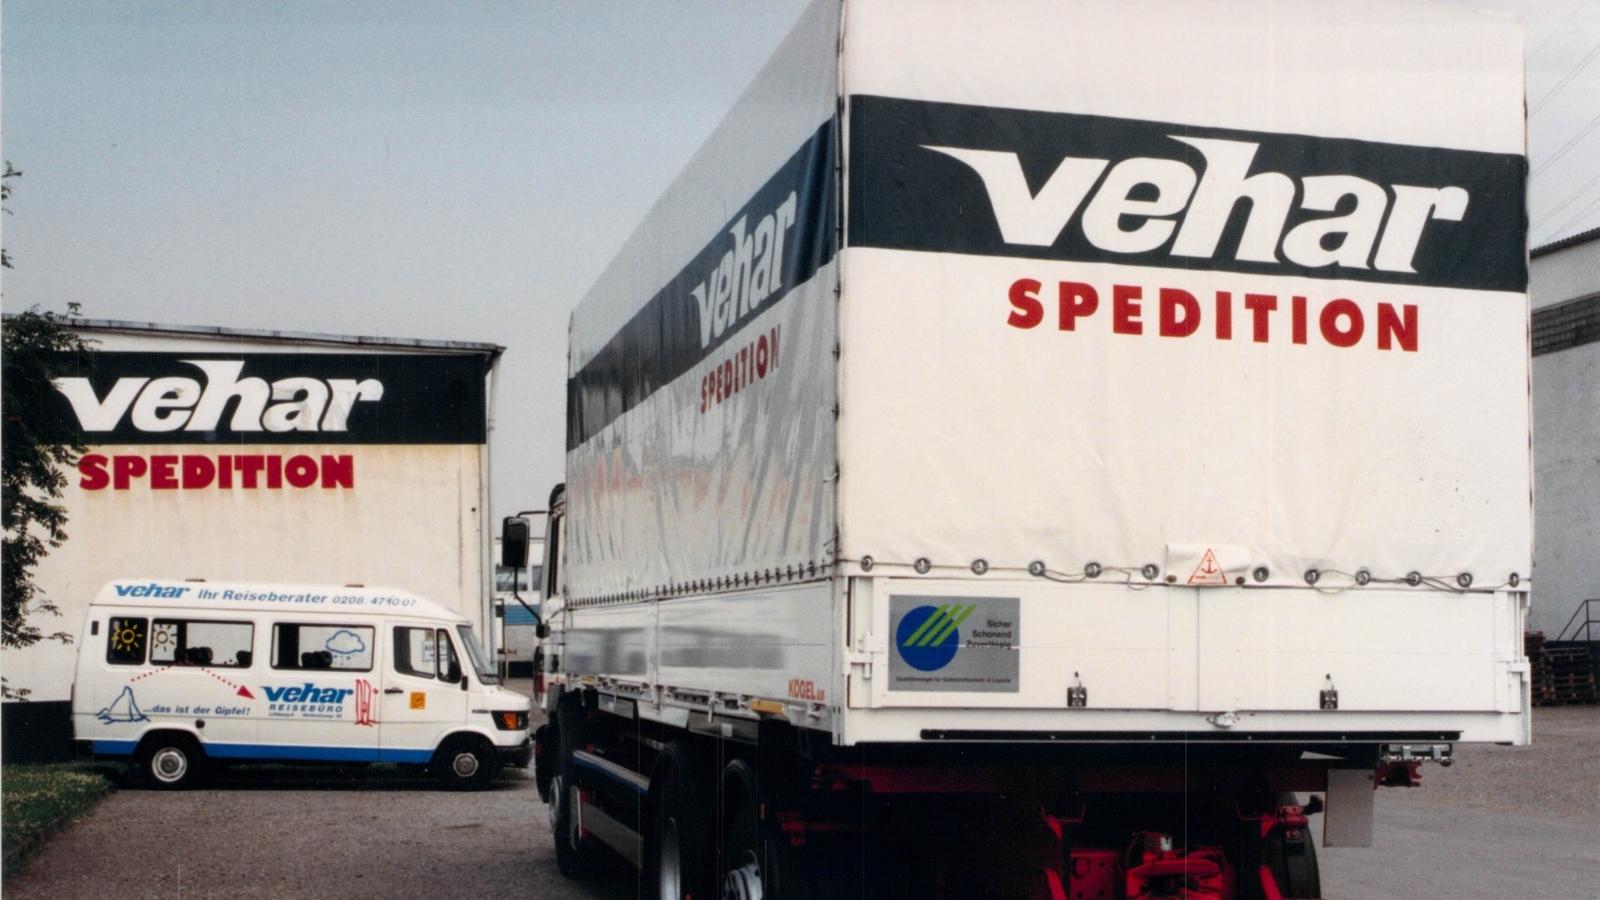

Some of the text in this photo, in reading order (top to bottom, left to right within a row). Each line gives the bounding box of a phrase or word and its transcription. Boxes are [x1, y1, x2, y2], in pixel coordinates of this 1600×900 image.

[918, 134, 1469, 273] vehar
[690, 190, 797, 350] vehar
[1007, 278, 1418, 352] SPEDITION
[51, 360, 384, 432] vehar
[700, 323, 782, 415] SPEDITION
[77, 454, 354, 490] SPEDITION
[115, 583, 191, 598] vehar
[198, 589, 219, 600] Ihr
[222, 590, 327, 604] Reiseberater
[175, 704, 189, 714] ist
[193, 705, 210, 714] der
[215, 706, 250, 716] Gipfel!
[260, 683, 354, 703] vehar
